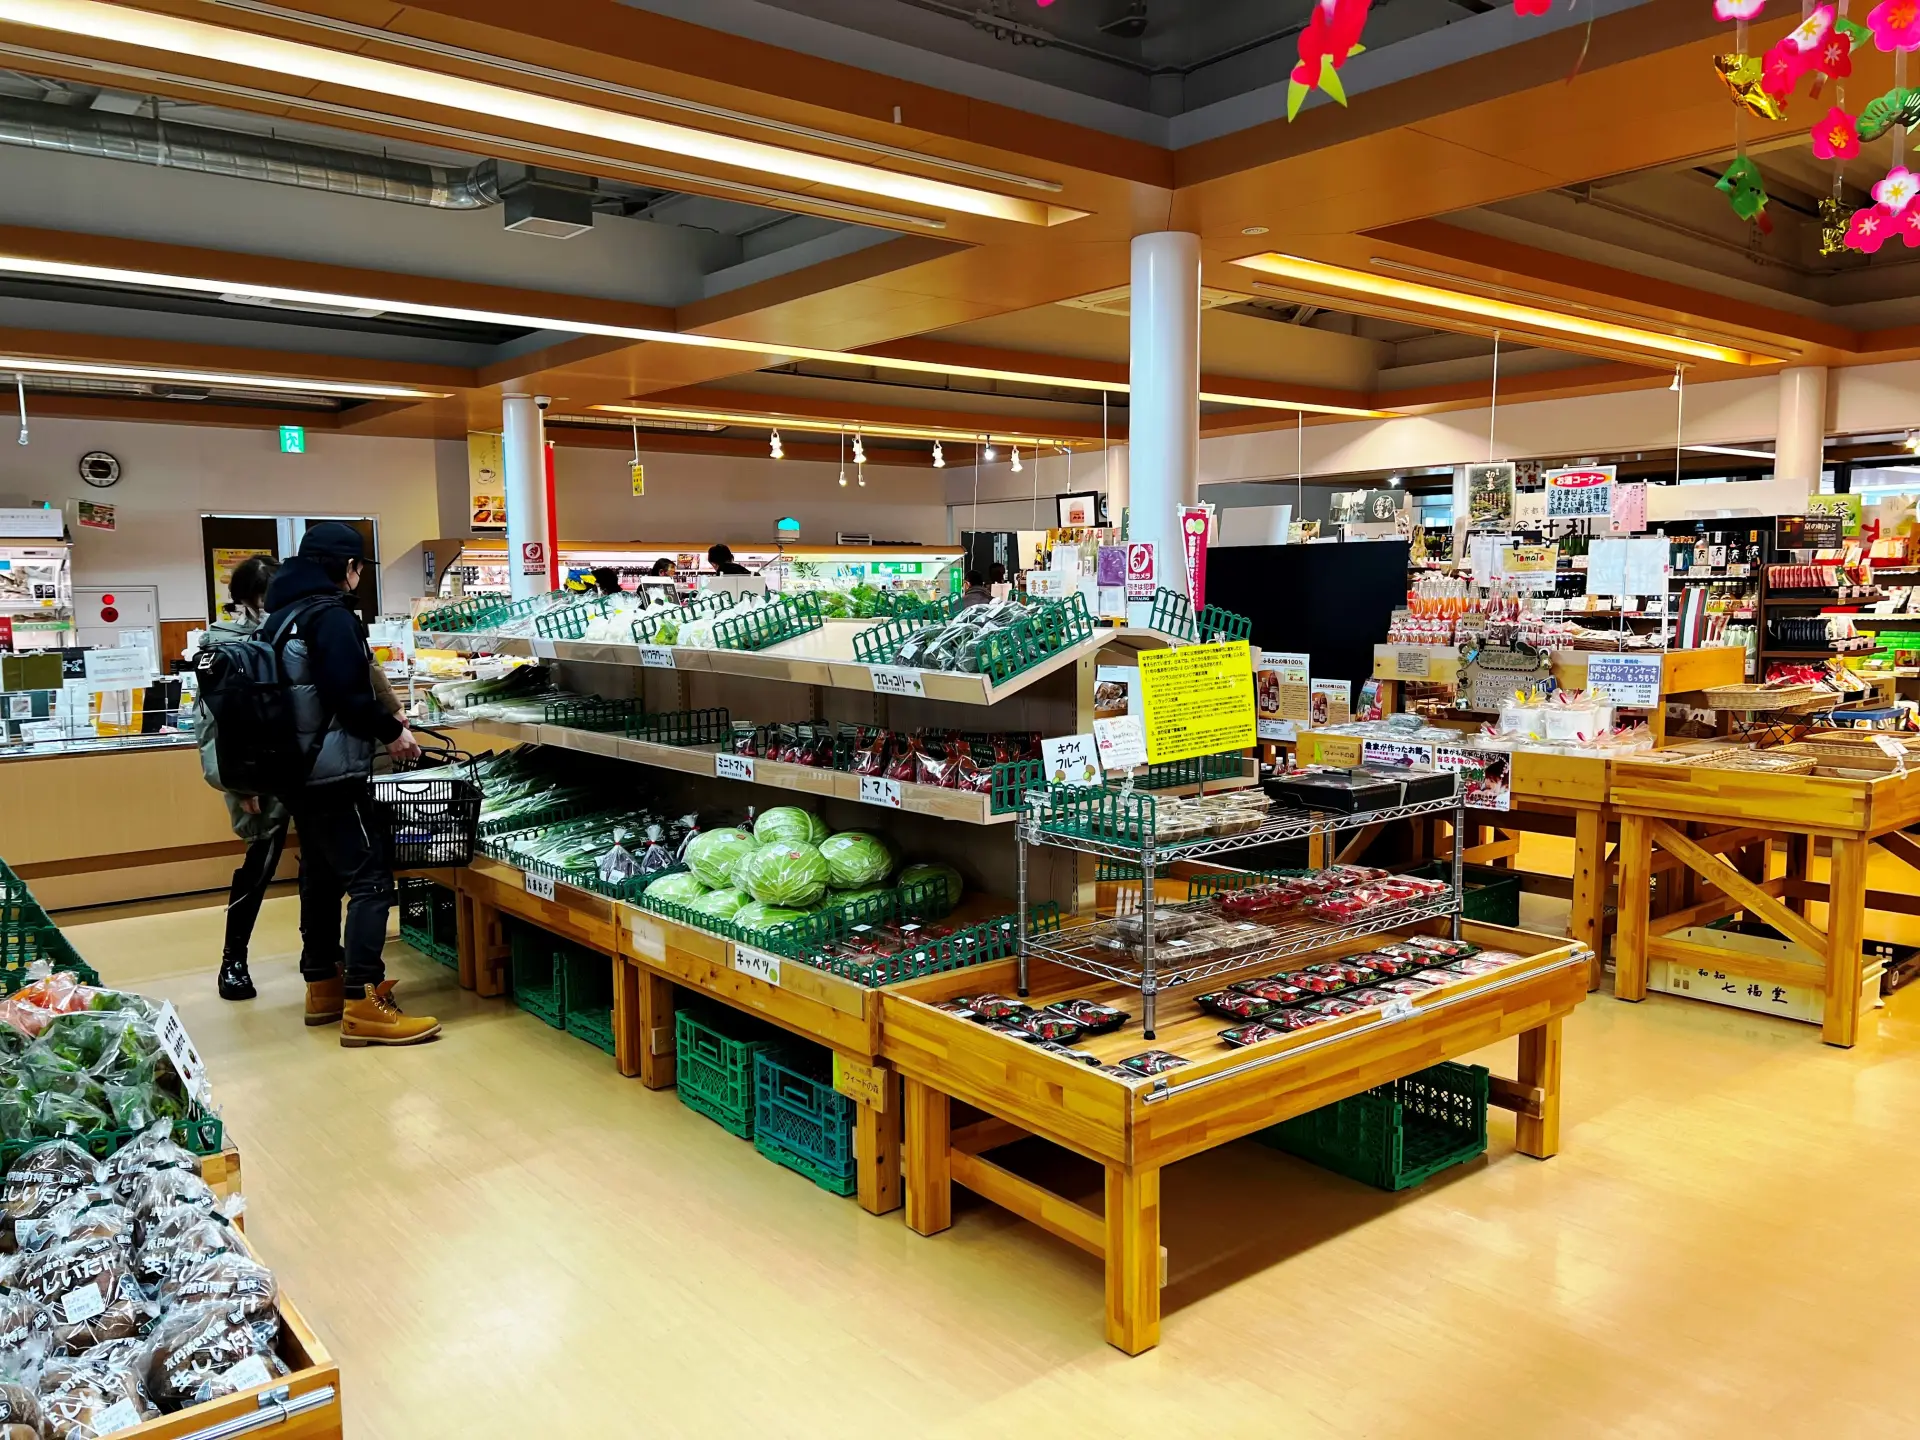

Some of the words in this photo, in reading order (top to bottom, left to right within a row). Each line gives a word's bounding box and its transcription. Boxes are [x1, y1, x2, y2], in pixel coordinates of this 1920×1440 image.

[1556, 475, 1605, 485] お酒コーナー
[1058, 741, 1080, 754] キウイ
[719, 757, 744, 772] ミニトマト
[1056, 755, 1087, 769] フルーツ
[862, 778, 892, 796] トマト
[737, 950, 770, 975] キャベツ
[1698, 968, 1726, 980] 和知
[1721, 982, 1788, 1004] 七福堂
